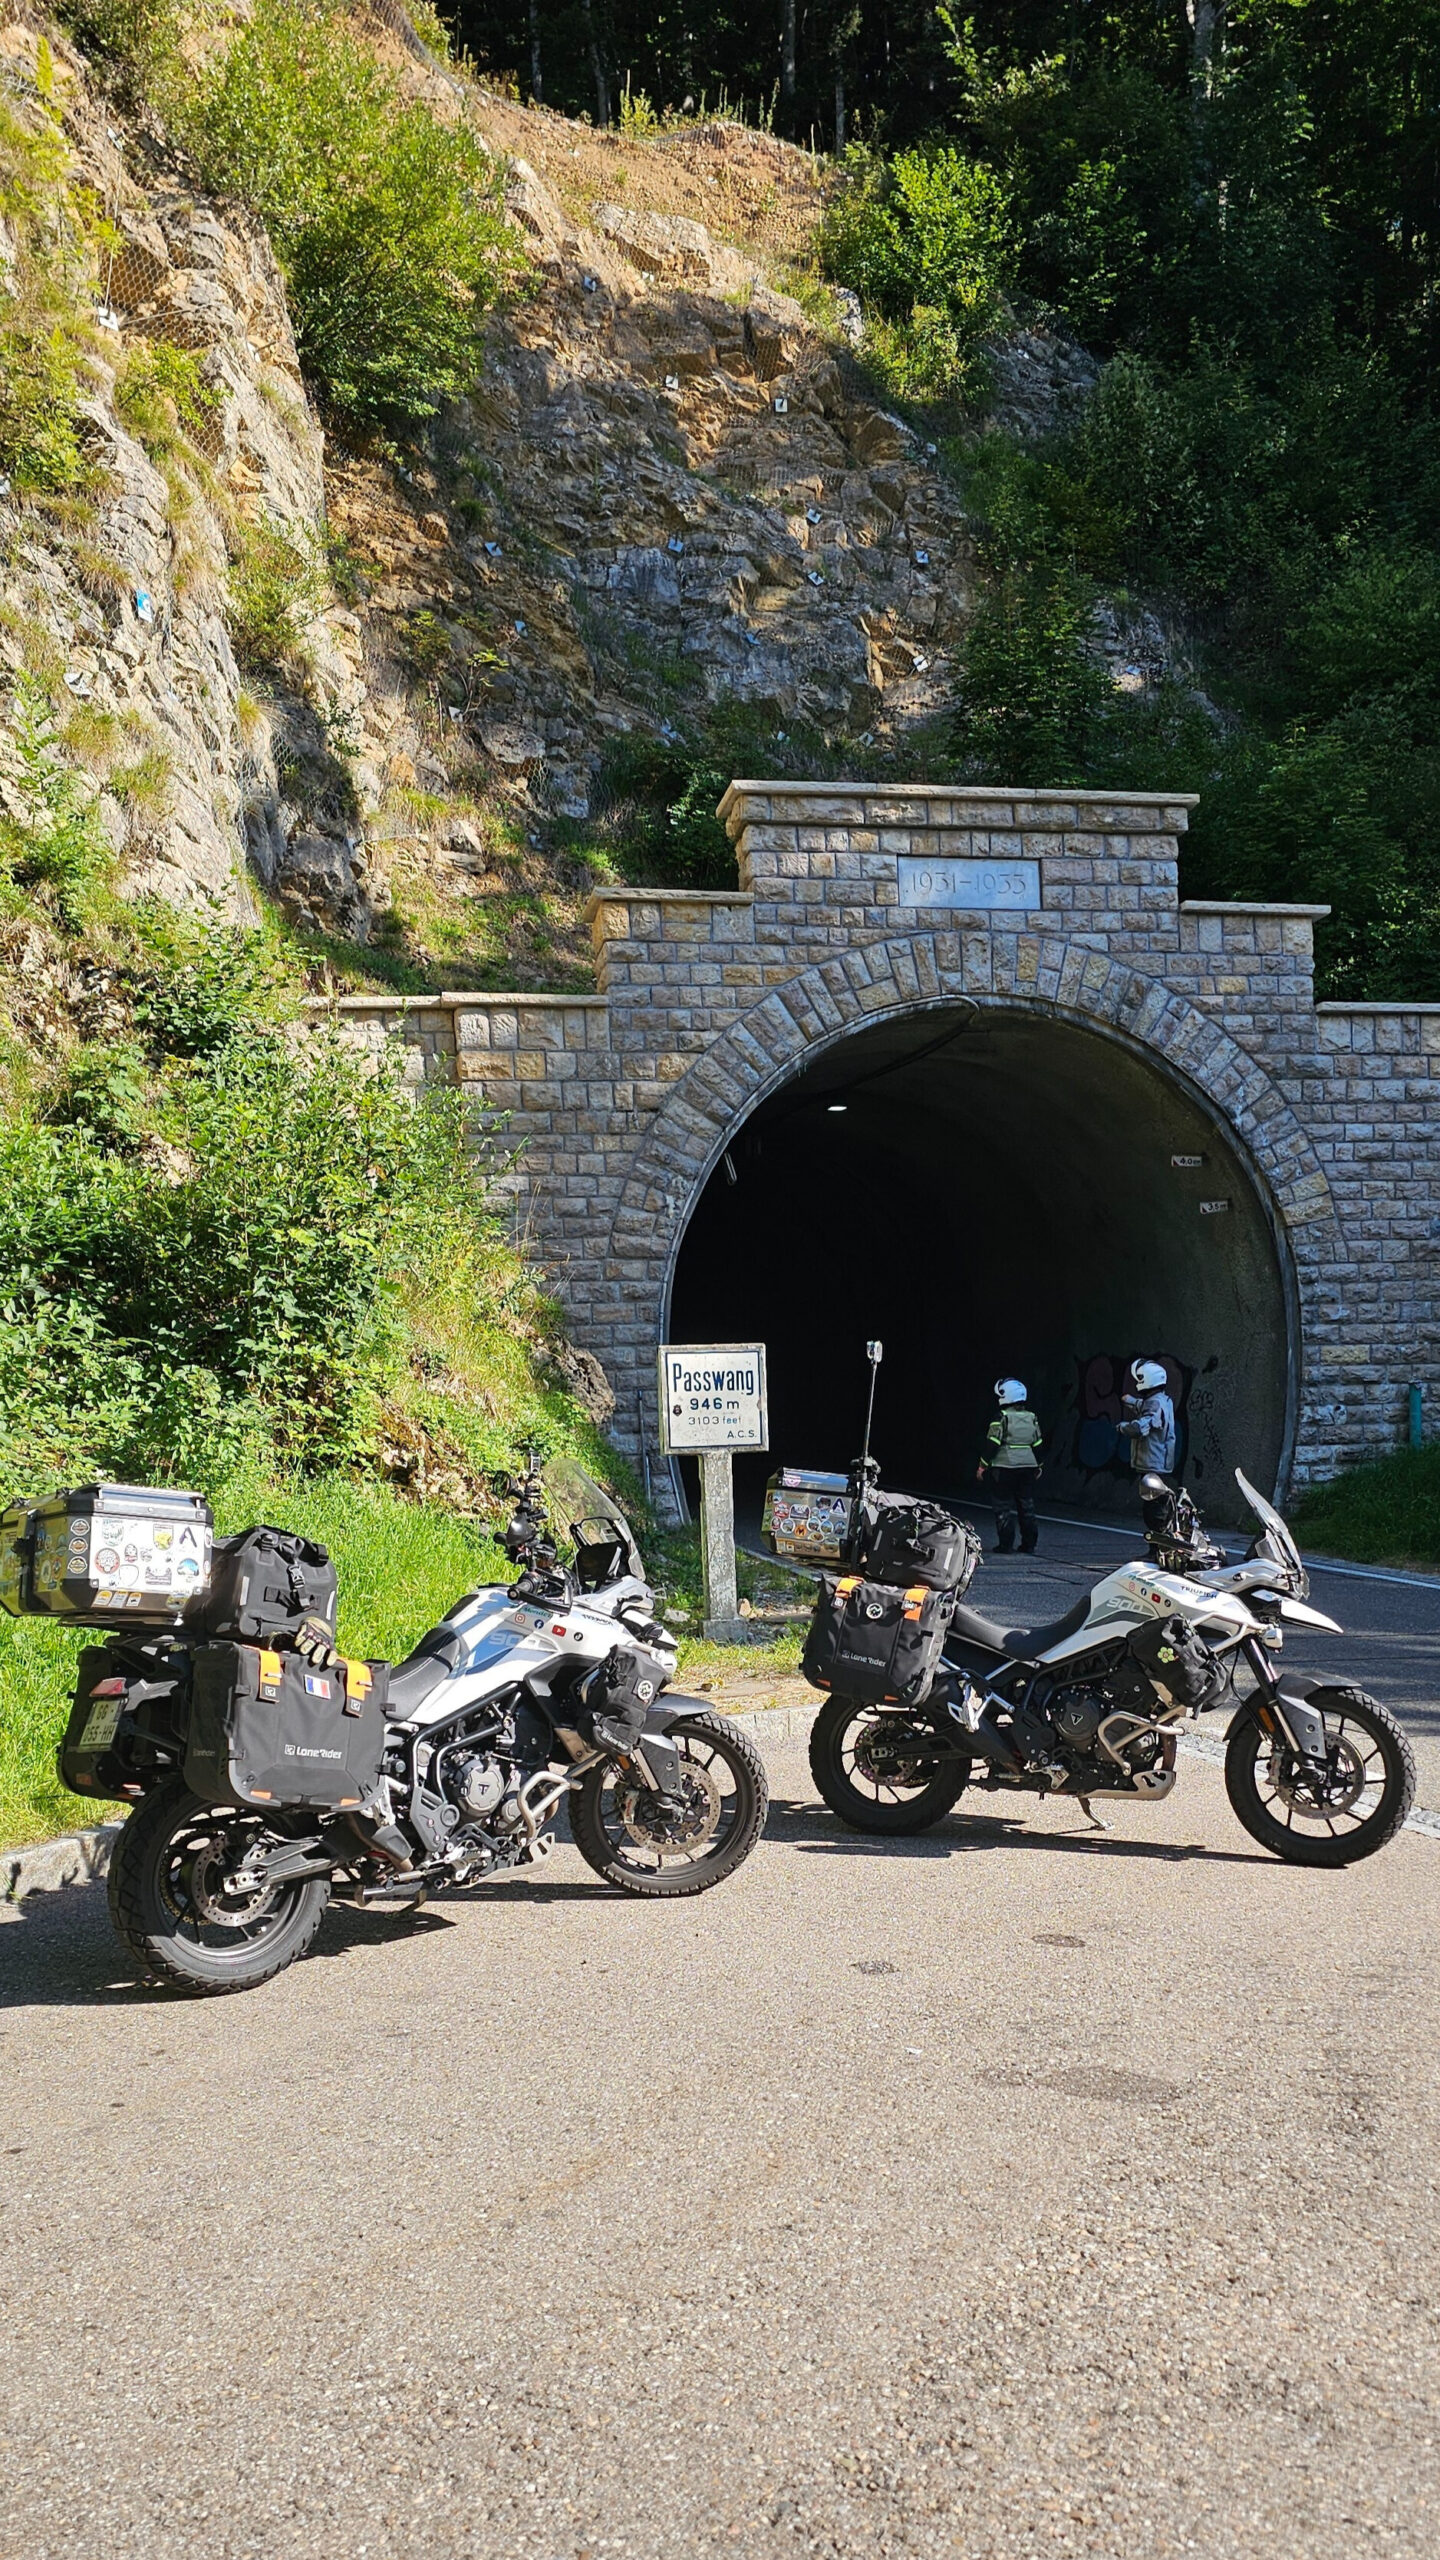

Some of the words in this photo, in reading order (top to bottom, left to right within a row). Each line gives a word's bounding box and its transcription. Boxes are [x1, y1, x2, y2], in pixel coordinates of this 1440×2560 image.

[672, 1363, 754, 1396] Passwang
[690, 1397, 723, 1410] 946
[726, 1400, 740, 1409] m
[688, 1416, 720, 1426] 3103
[722, 1415, 741, 1425] feet
[1106, 1597, 1143, 1612] 900
